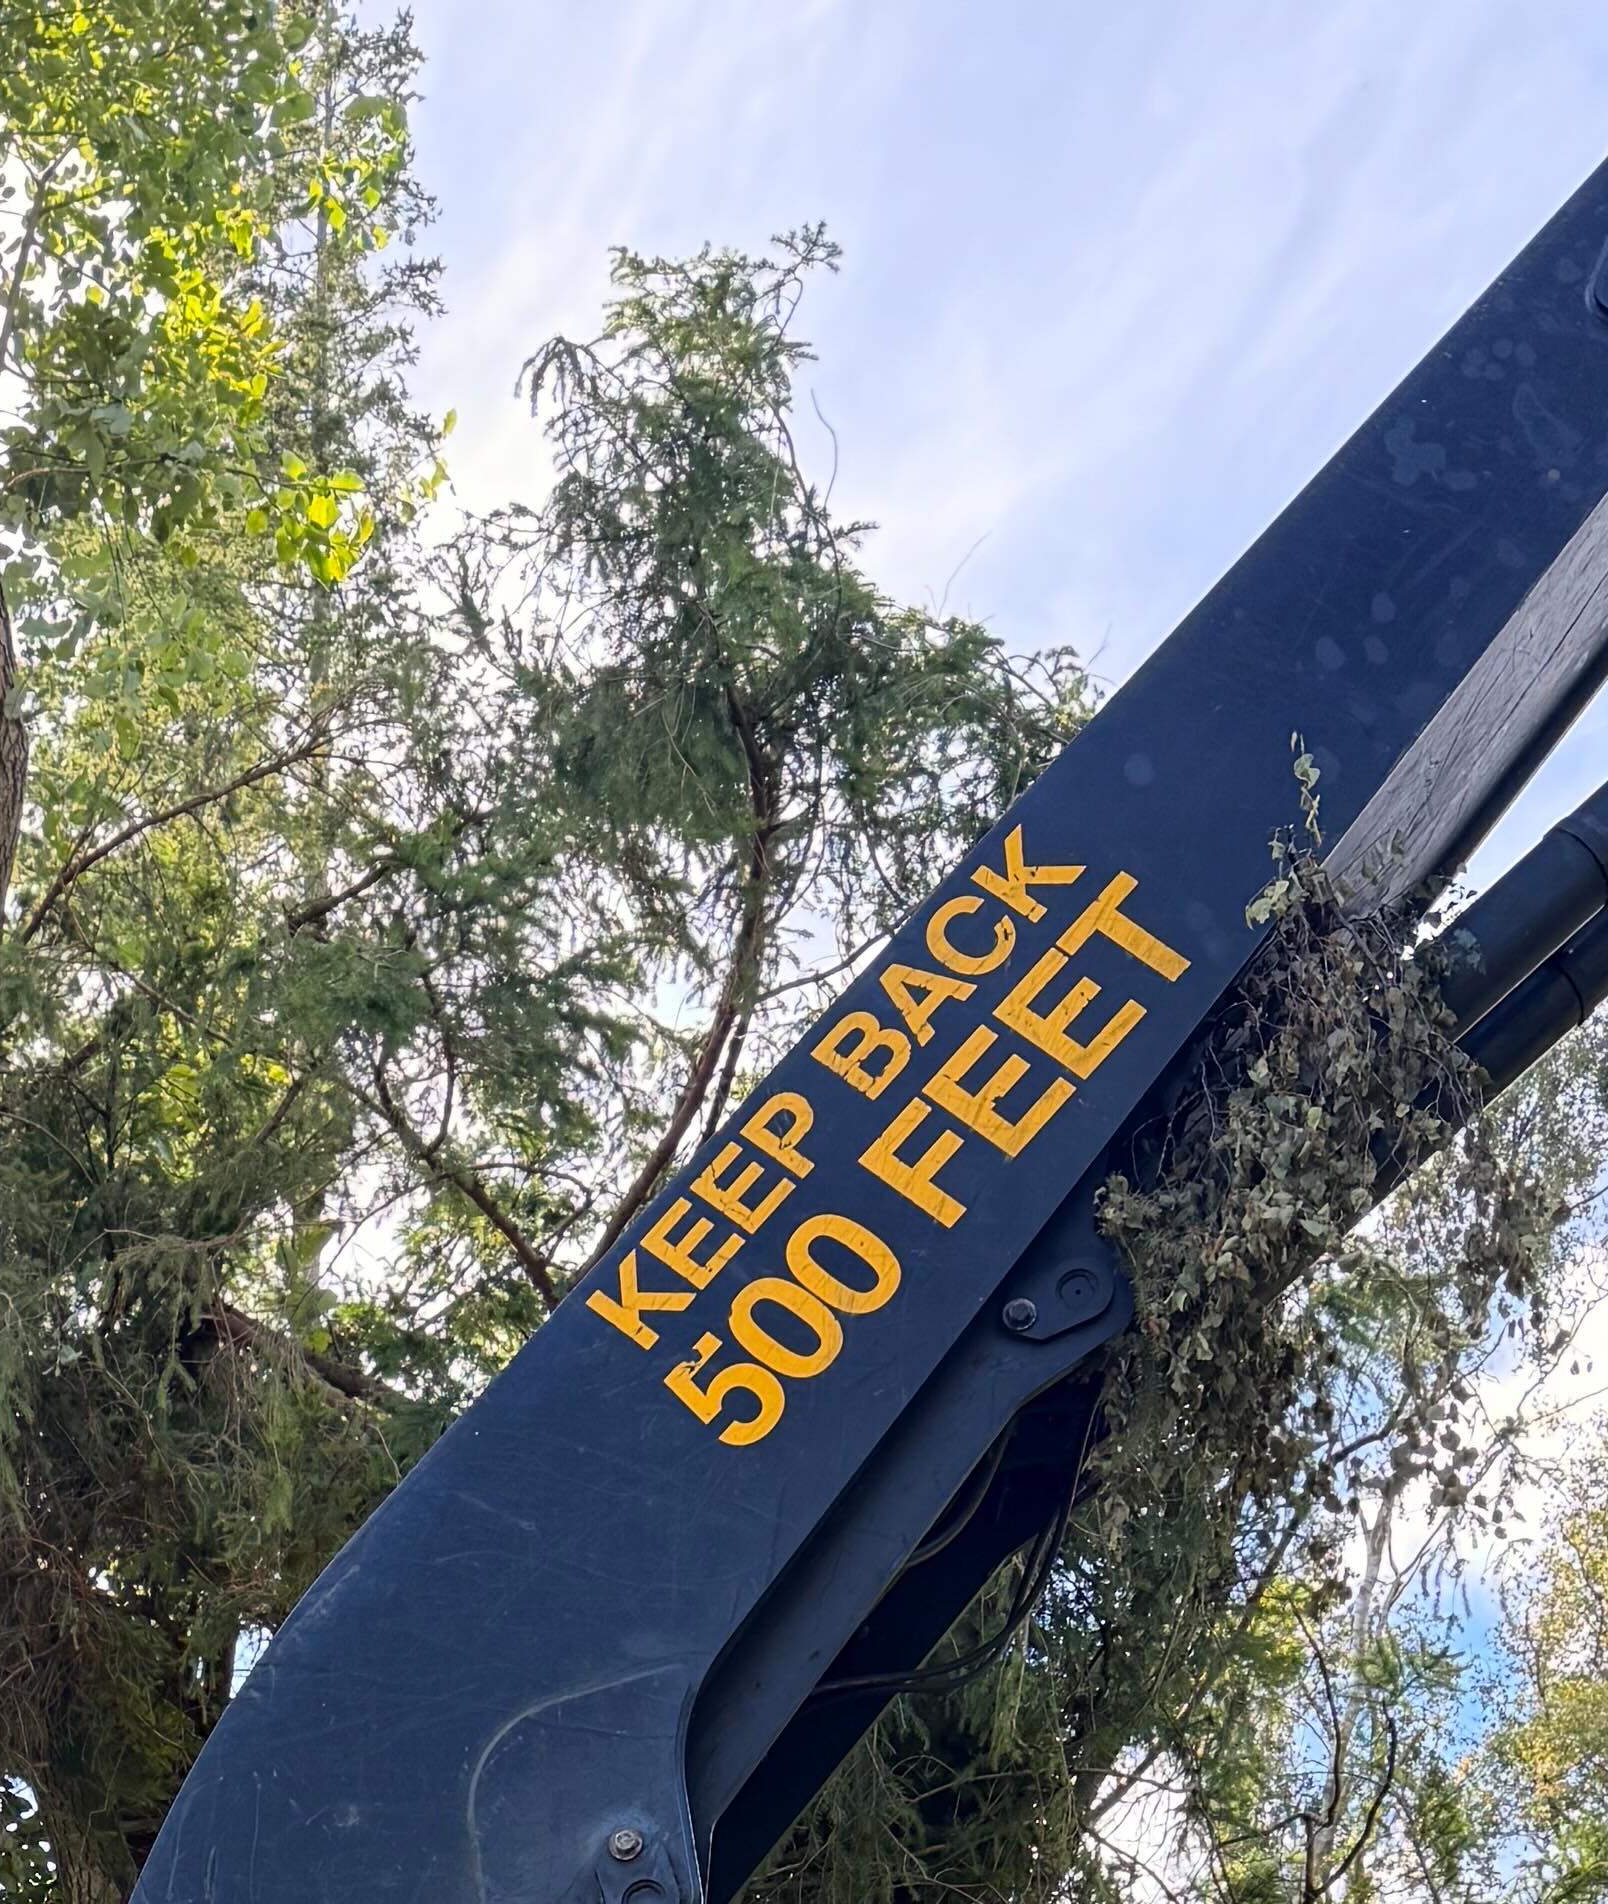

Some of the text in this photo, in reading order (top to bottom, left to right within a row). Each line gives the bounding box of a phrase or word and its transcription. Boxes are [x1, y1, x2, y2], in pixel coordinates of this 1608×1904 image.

[586, 824, 1087, 1351] KEEP BACK
[663, 870, 1192, 1447] 500 FEET
